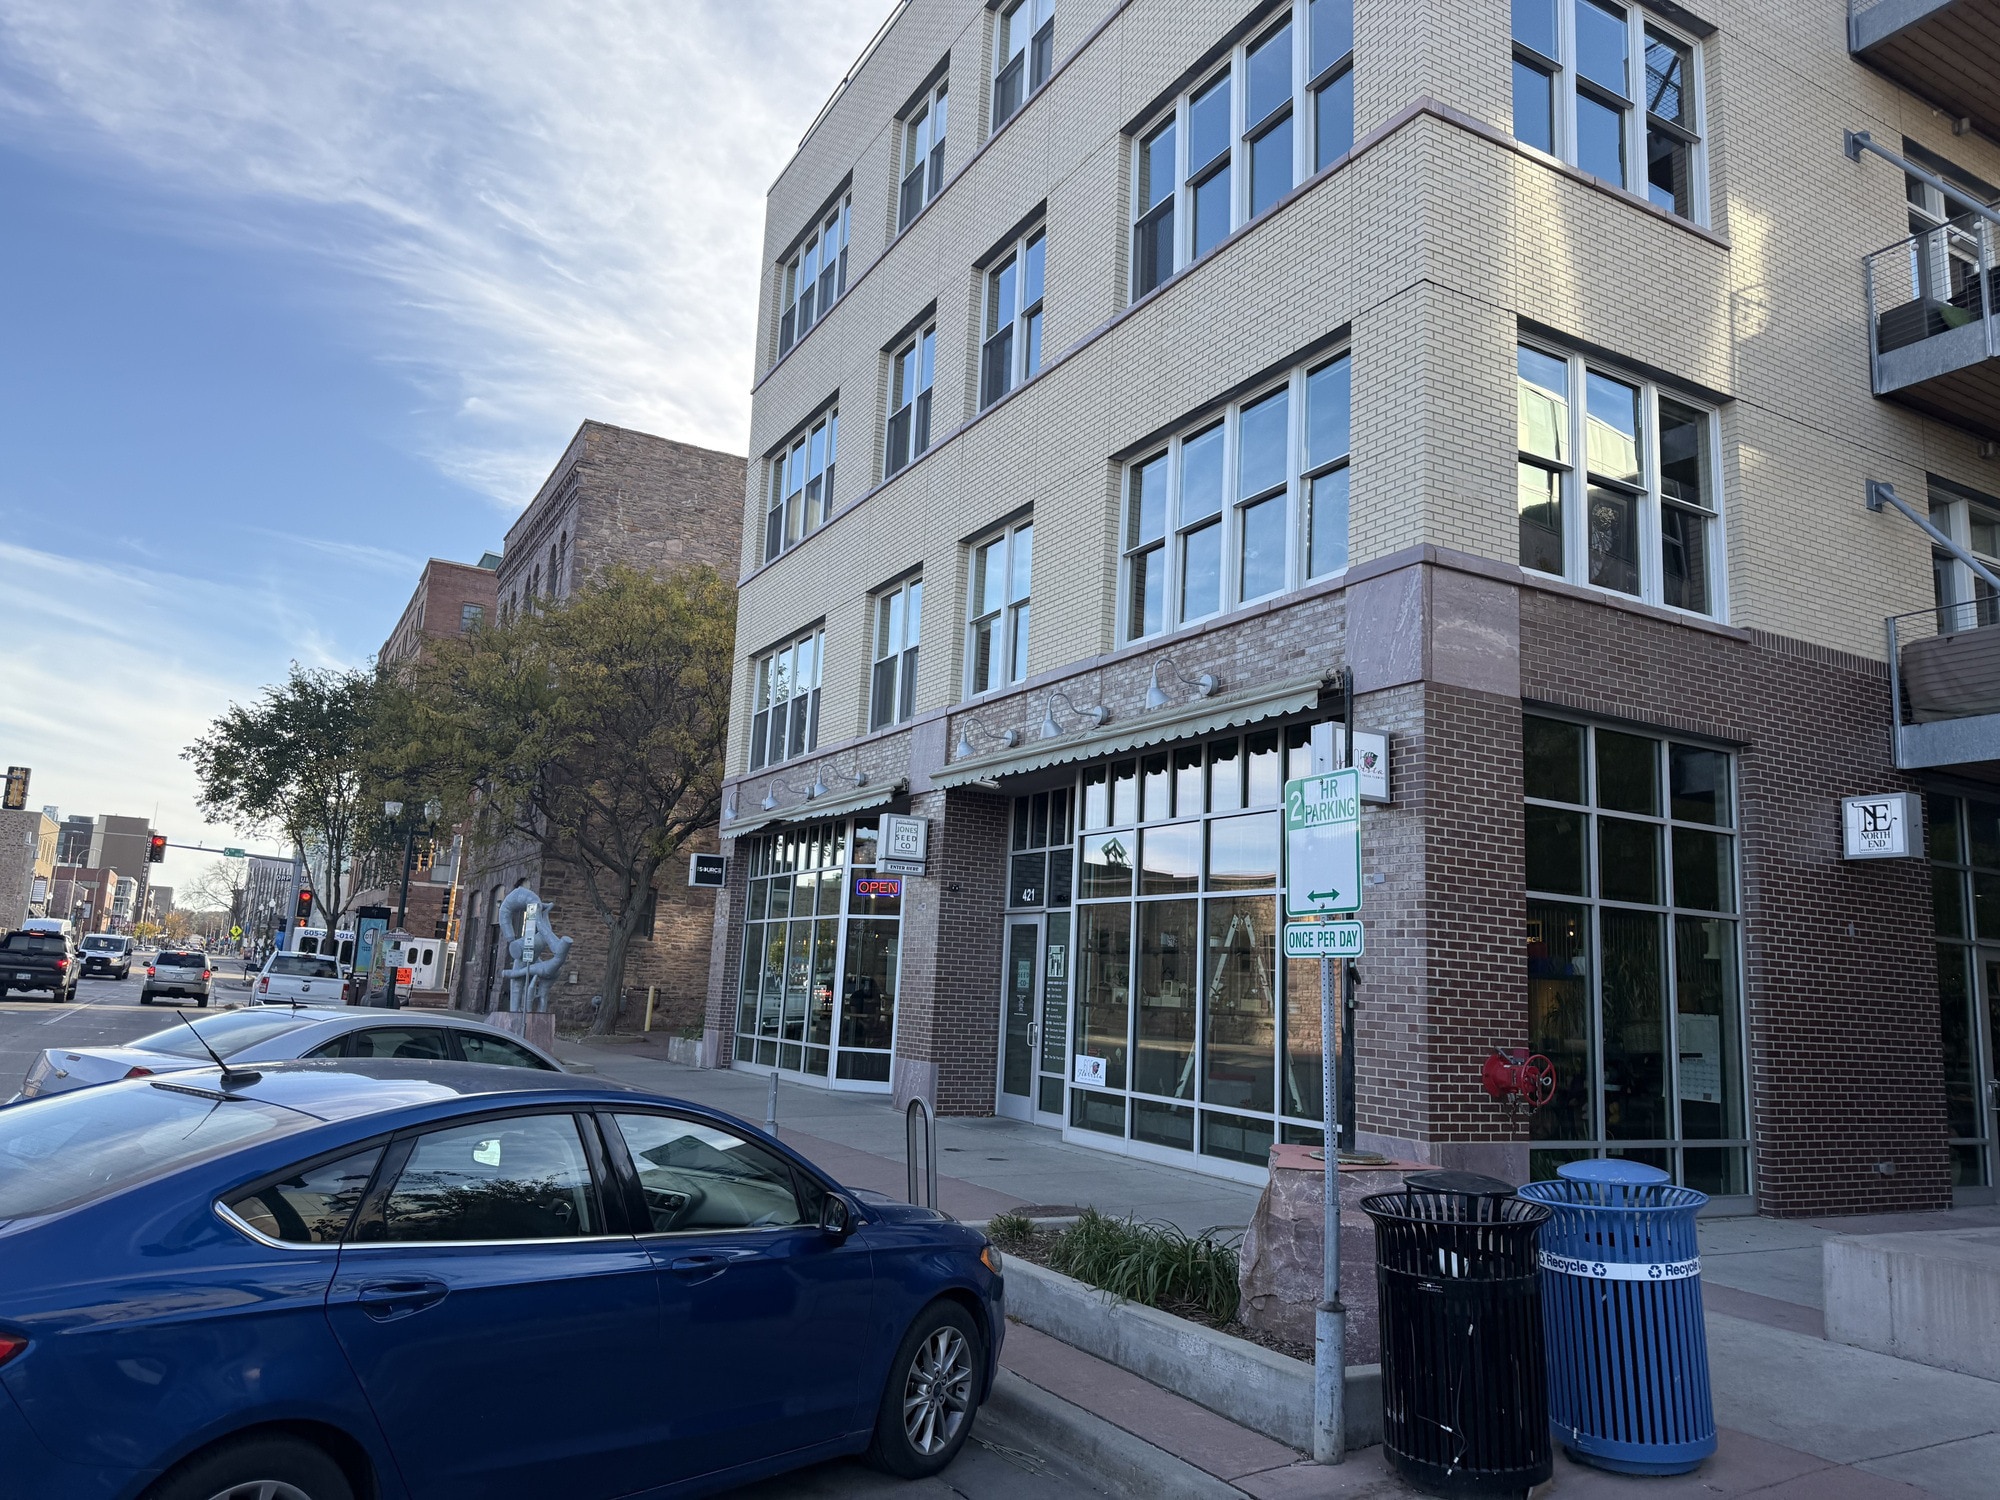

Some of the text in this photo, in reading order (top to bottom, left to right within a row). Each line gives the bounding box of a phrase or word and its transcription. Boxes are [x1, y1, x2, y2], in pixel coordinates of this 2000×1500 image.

[1290, 779, 1338, 822] 2 HR
[1305, 797, 1355, 824] PARKING
[896, 826, 918, 834] JONES
[1860, 831, 1891, 841] NORTH
[895, 834, 917, 842] SEED
[1868, 839, 1886, 848] END
[699, 866, 722, 874] SOURCE
[859, 881, 898, 893] OPEN
[1022, 888, 1035, 901] 421
[1289, 930, 1358, 948] ONCE PER DAY
[1546, 1254, 1698, 1277] Recycle Recycle
